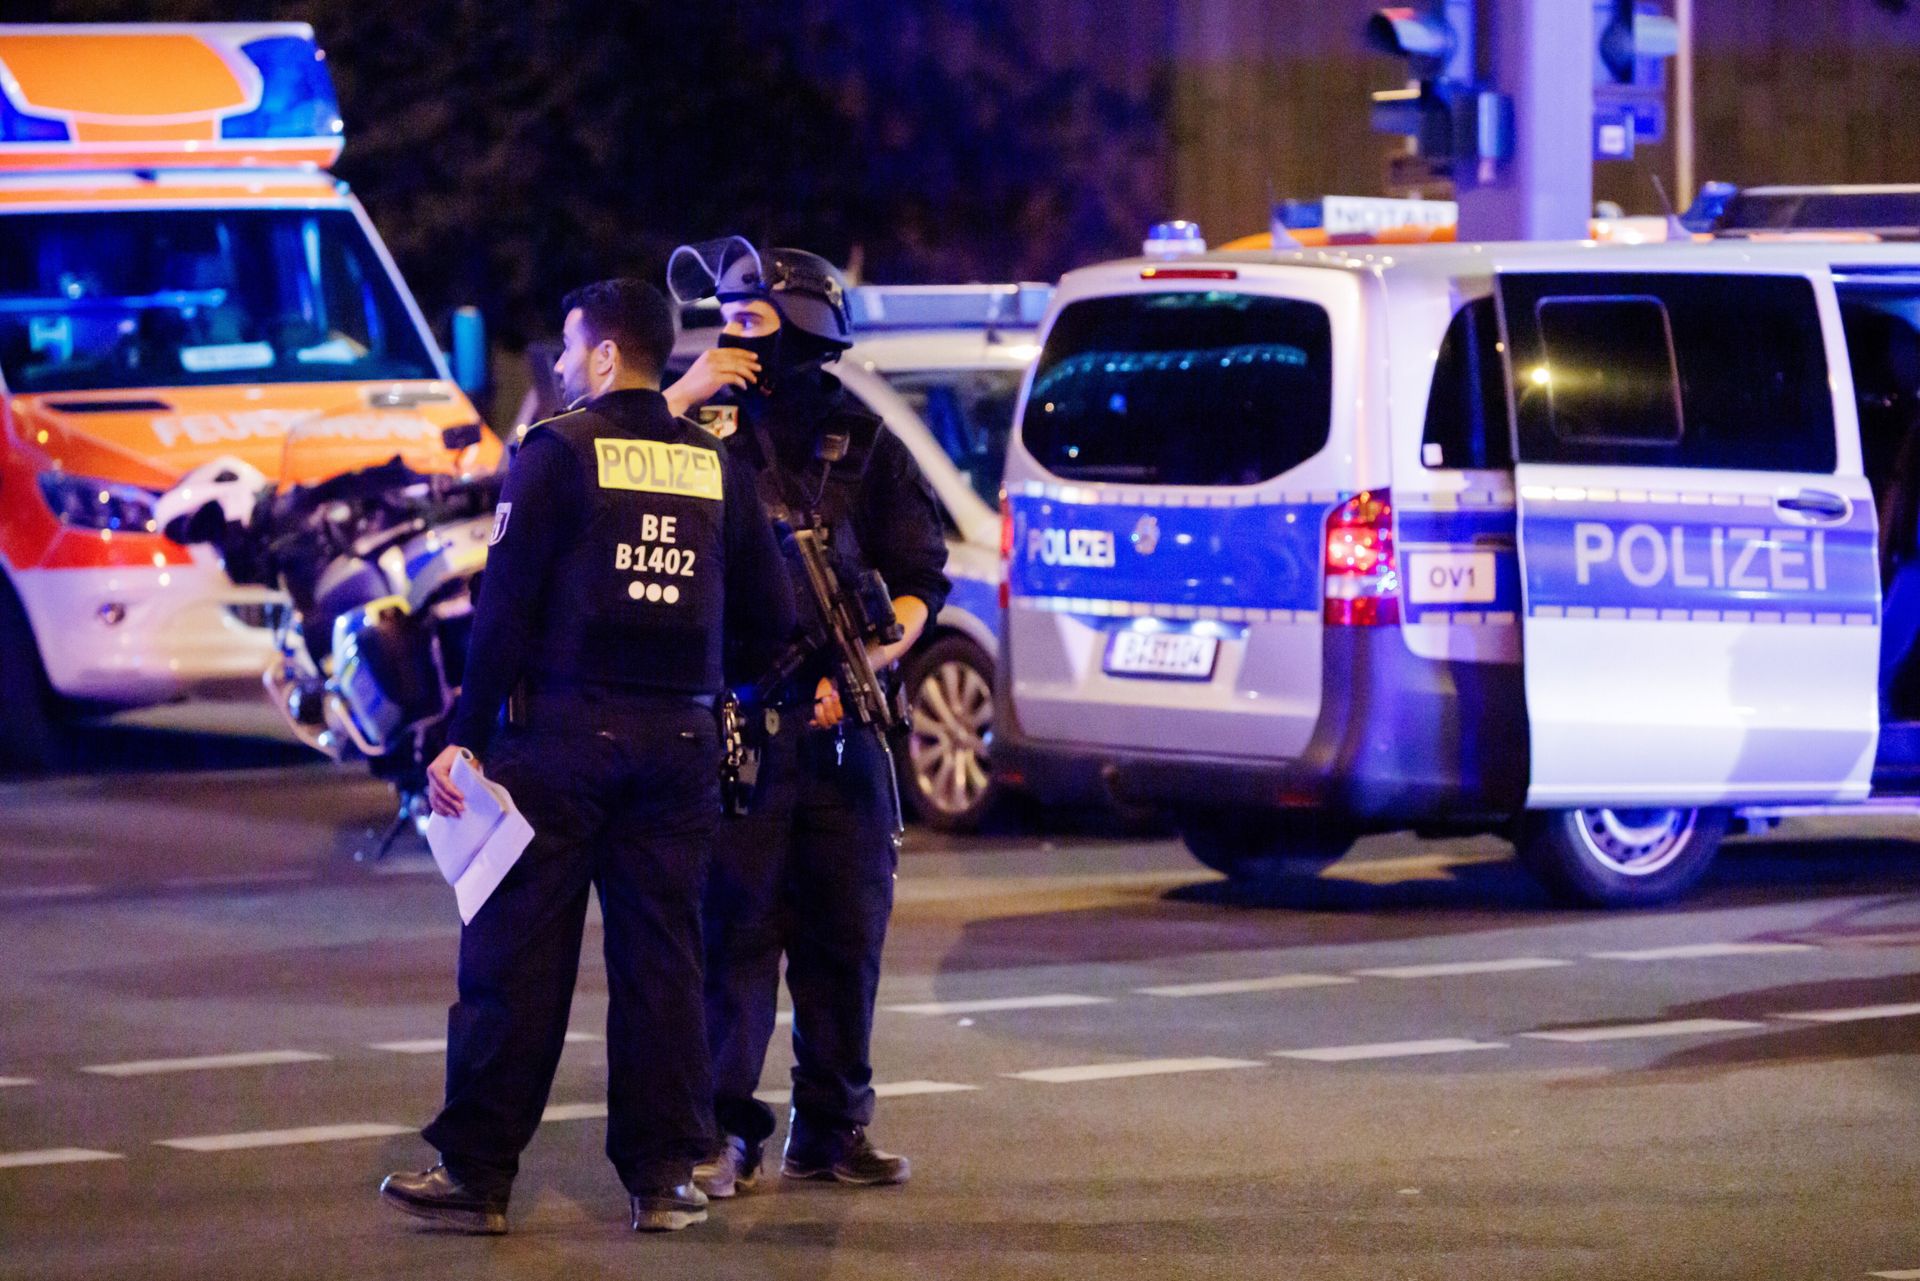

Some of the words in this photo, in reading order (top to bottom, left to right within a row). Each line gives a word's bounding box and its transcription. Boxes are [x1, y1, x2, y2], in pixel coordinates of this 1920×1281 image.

[641, 513, 677, 544] BE
[615, 543, 696, 577] B1402
[1575, 521, 1827, 590] POLIZEI
[1429, 565, 1476, 588] OV1
